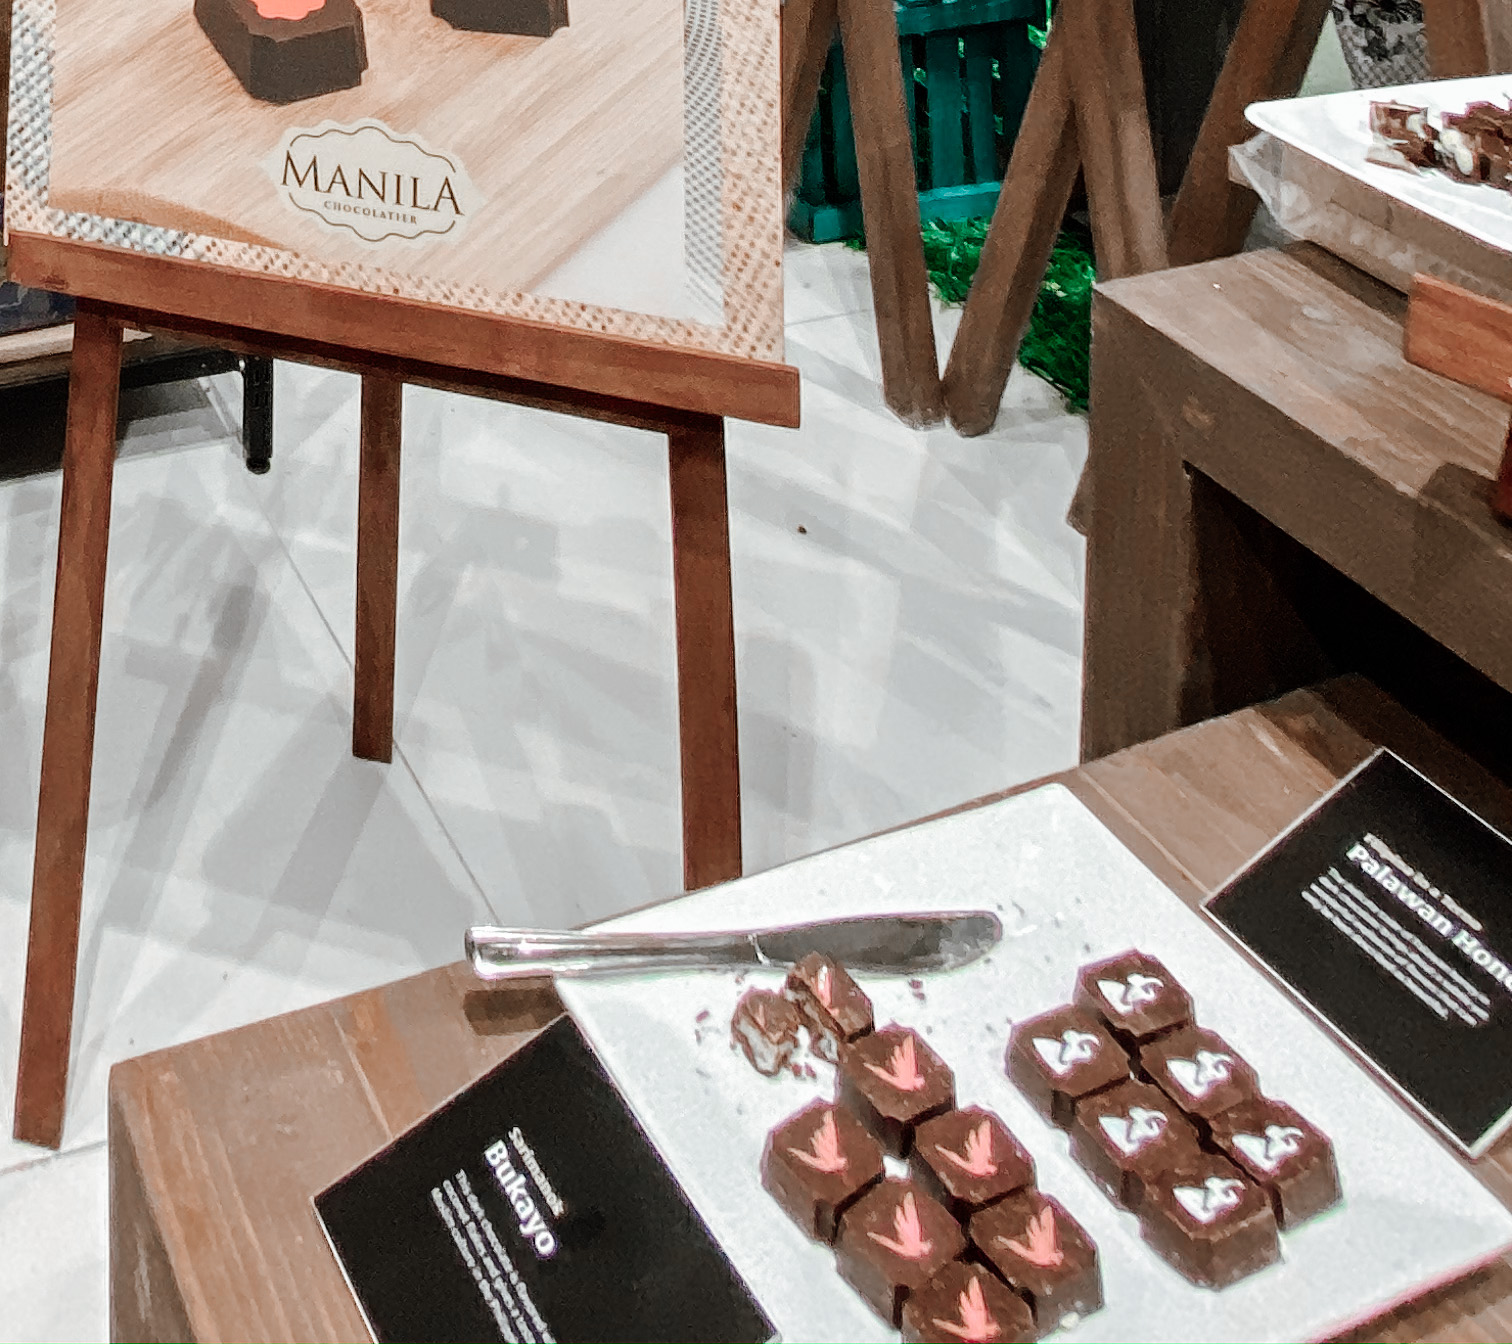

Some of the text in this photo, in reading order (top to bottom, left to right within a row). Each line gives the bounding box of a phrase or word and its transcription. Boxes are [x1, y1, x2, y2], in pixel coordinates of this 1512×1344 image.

[281, 149, 465, 216] MANILA
[324, 199, 418, 225] CHOCOLATIER
[1345, 843, 1455, 938] Palawan
[484, 1139, 556, 1256] Bukayo
